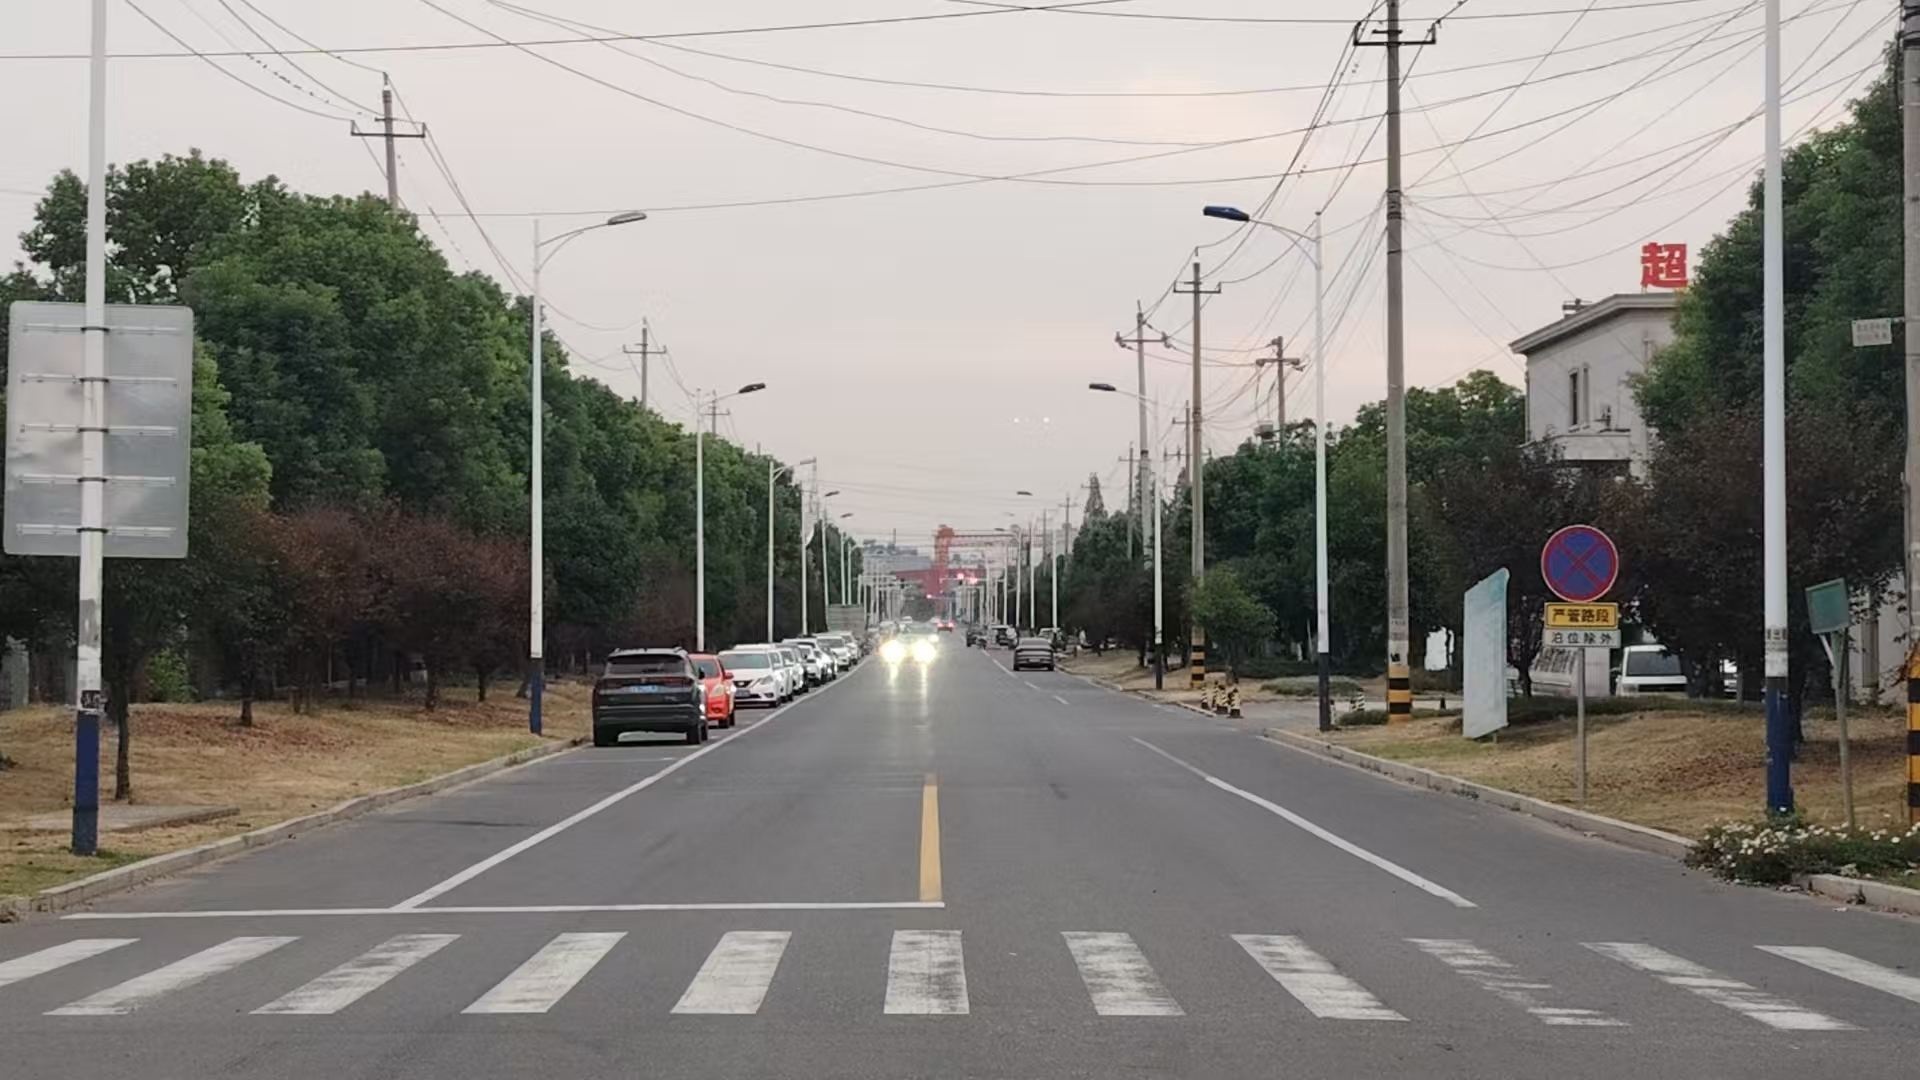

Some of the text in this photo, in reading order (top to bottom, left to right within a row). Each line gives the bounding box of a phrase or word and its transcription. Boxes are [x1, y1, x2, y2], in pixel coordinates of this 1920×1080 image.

[1641, 242, 1688, 288] 超
[1552, 608, 1609, 623] 严管路段
[1551, 632, 1612, 645] 泊位除外
